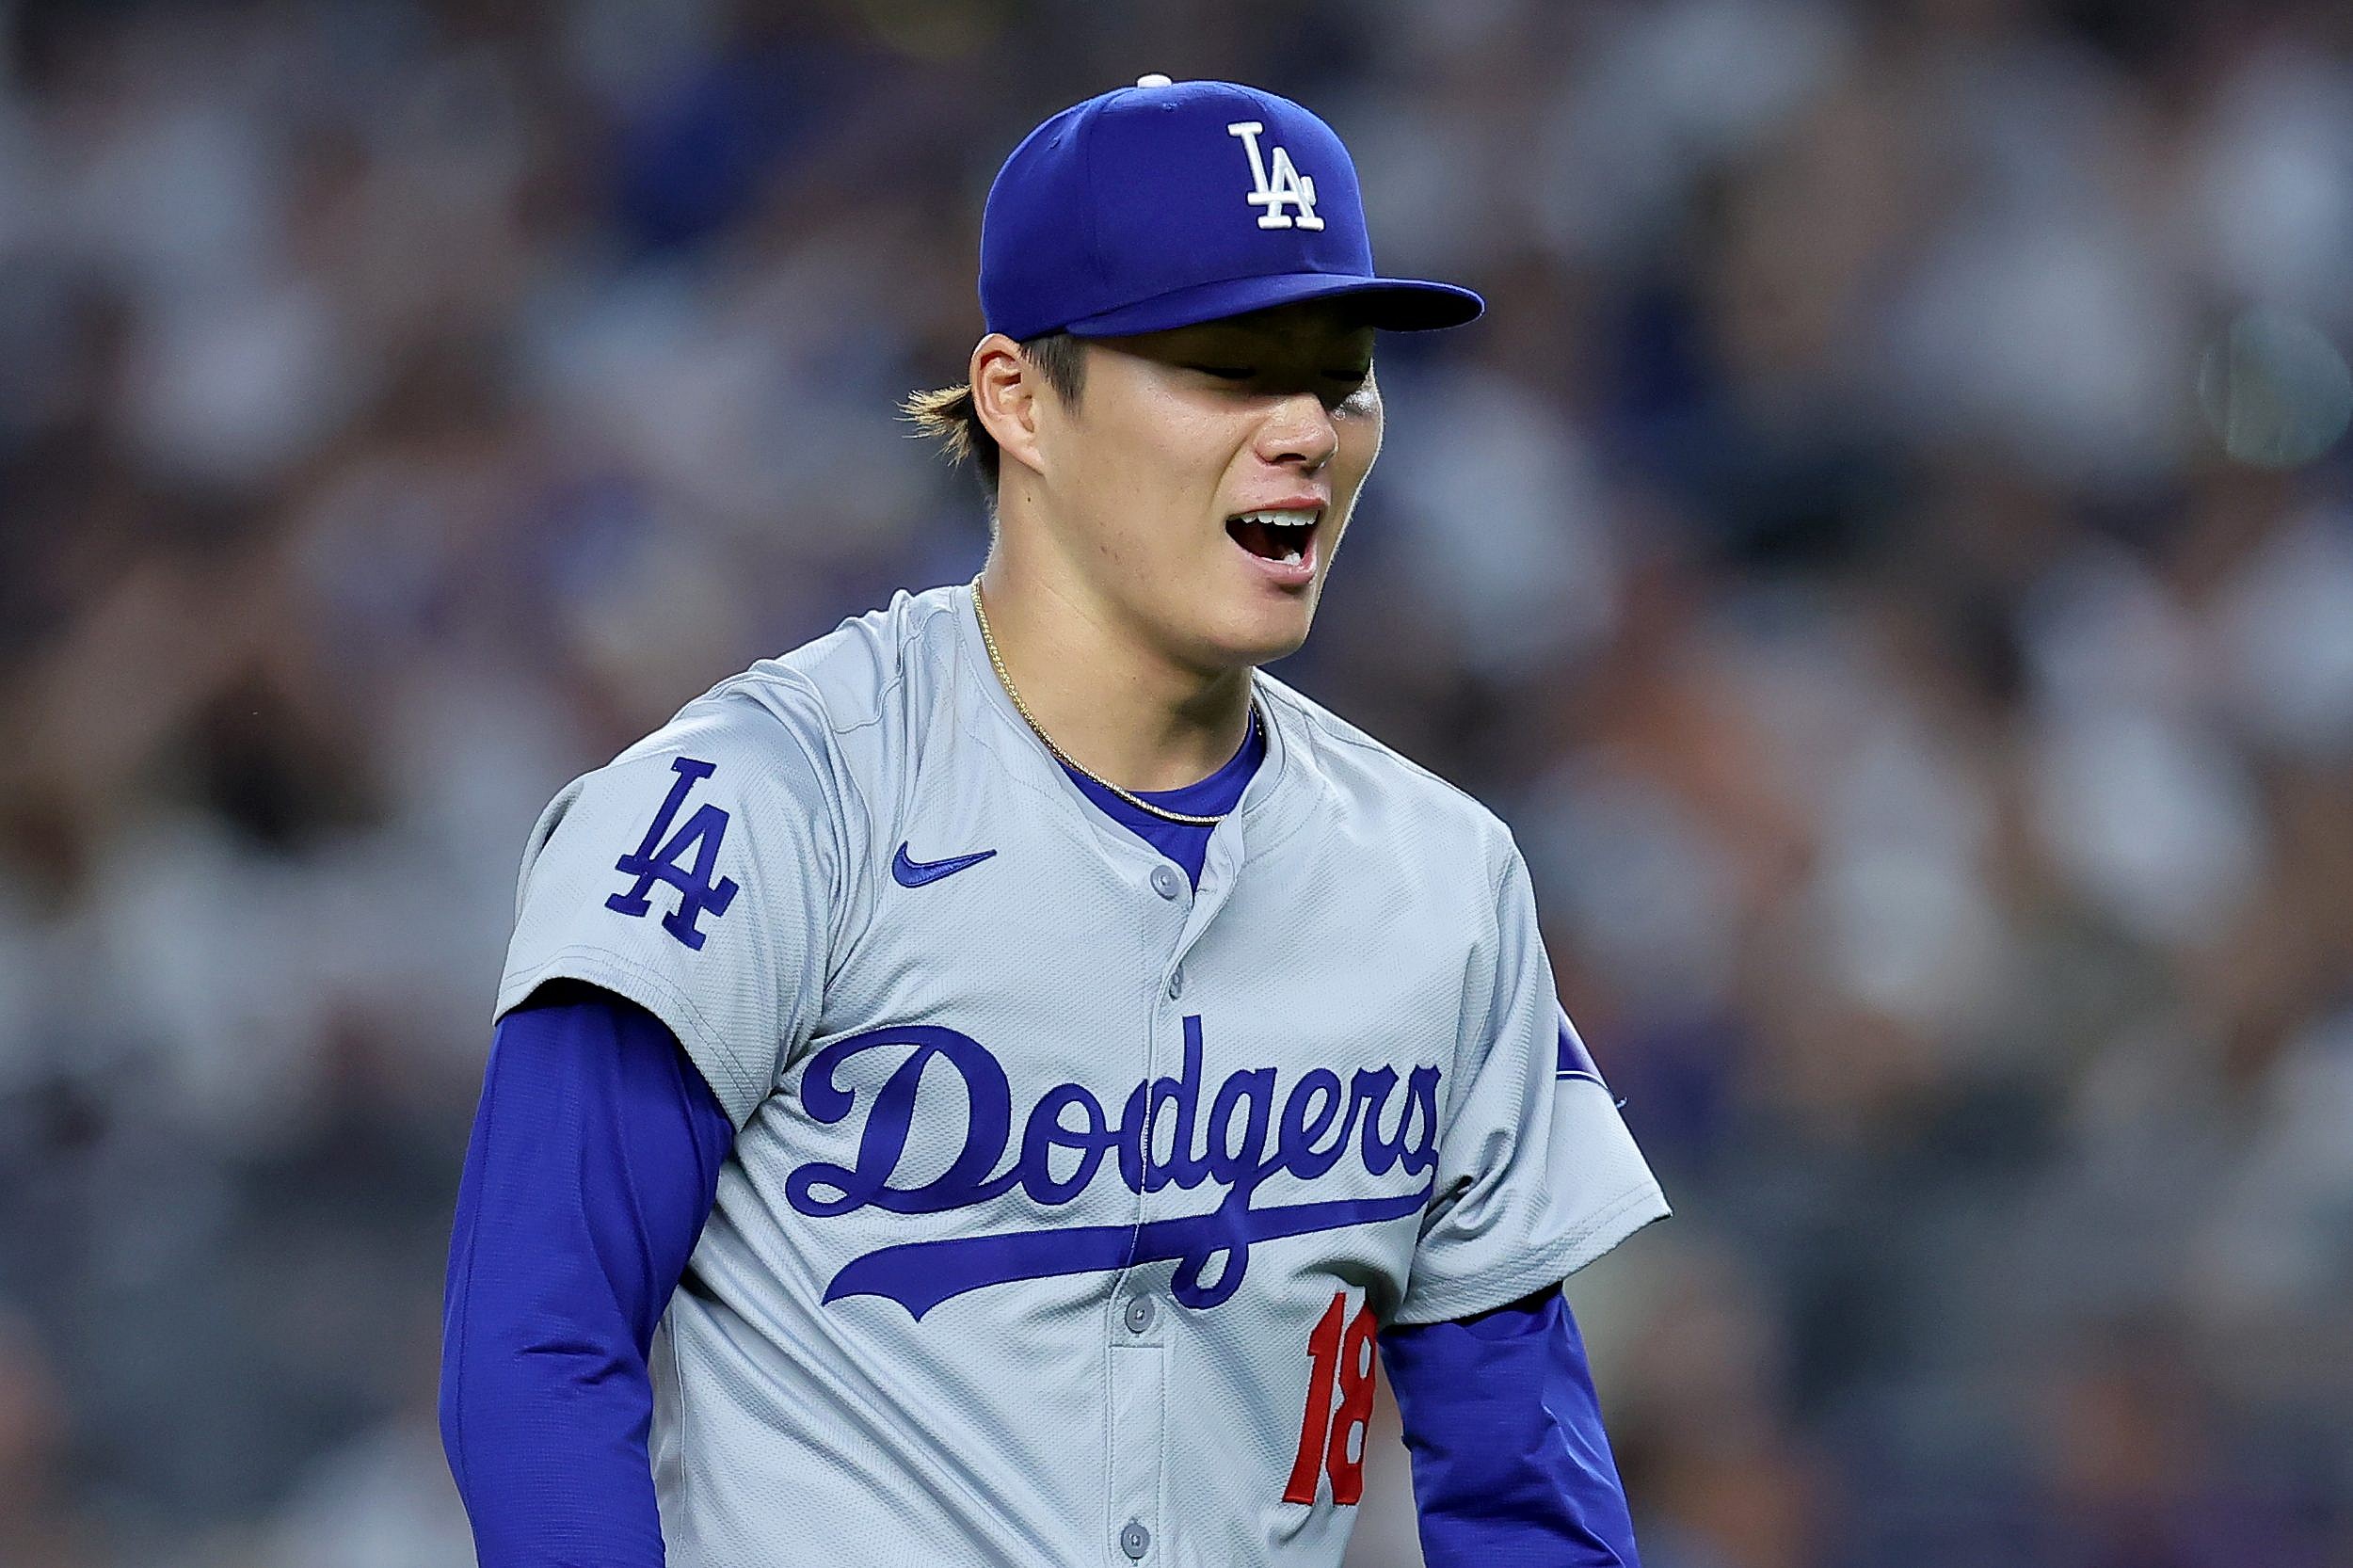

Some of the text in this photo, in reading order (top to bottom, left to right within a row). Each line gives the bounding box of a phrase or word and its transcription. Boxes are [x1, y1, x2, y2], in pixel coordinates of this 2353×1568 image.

[1227, 120, 1324, 231] LA
[604, 756, 740, 952] LA
[785, 1016, 1442, 1309] Dodgers
[1282, 1291, 1378, 1506] 18
